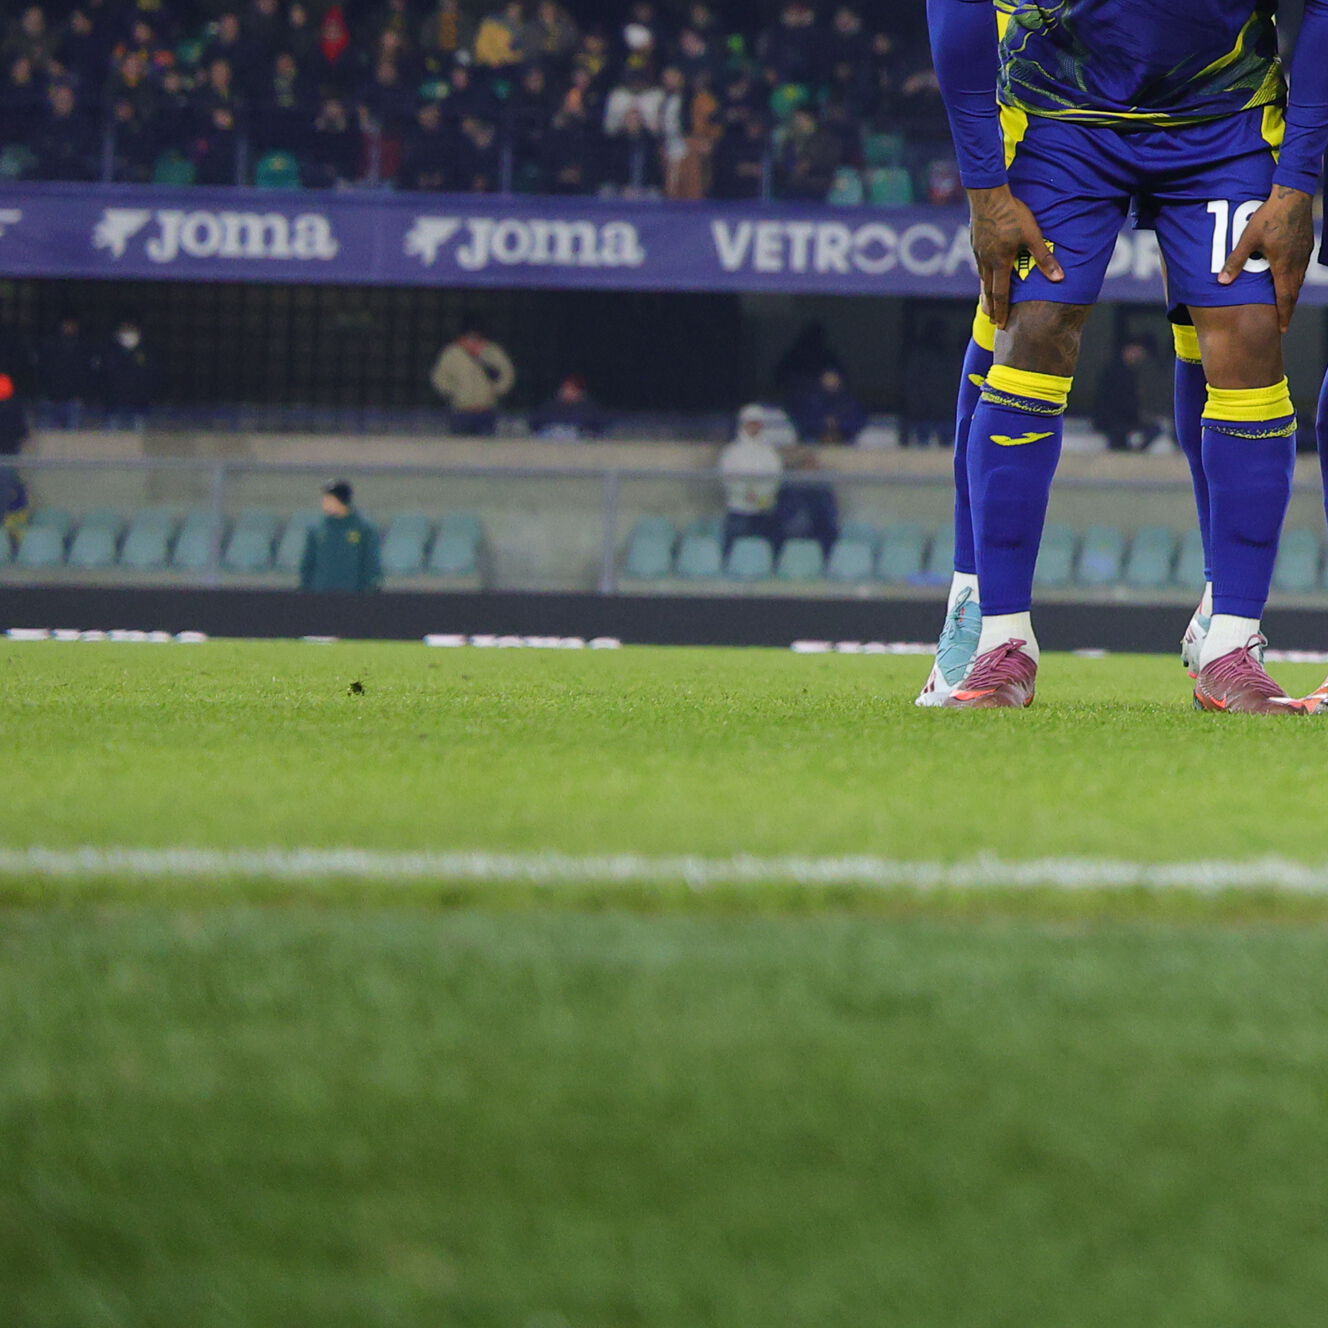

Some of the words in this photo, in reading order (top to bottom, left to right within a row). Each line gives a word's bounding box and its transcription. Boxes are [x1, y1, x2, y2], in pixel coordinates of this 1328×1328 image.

[147, 208, 339, 263] Joma
[456, 215, 646, 269] Joma
[710, 219, 978, 277] VETROCA
